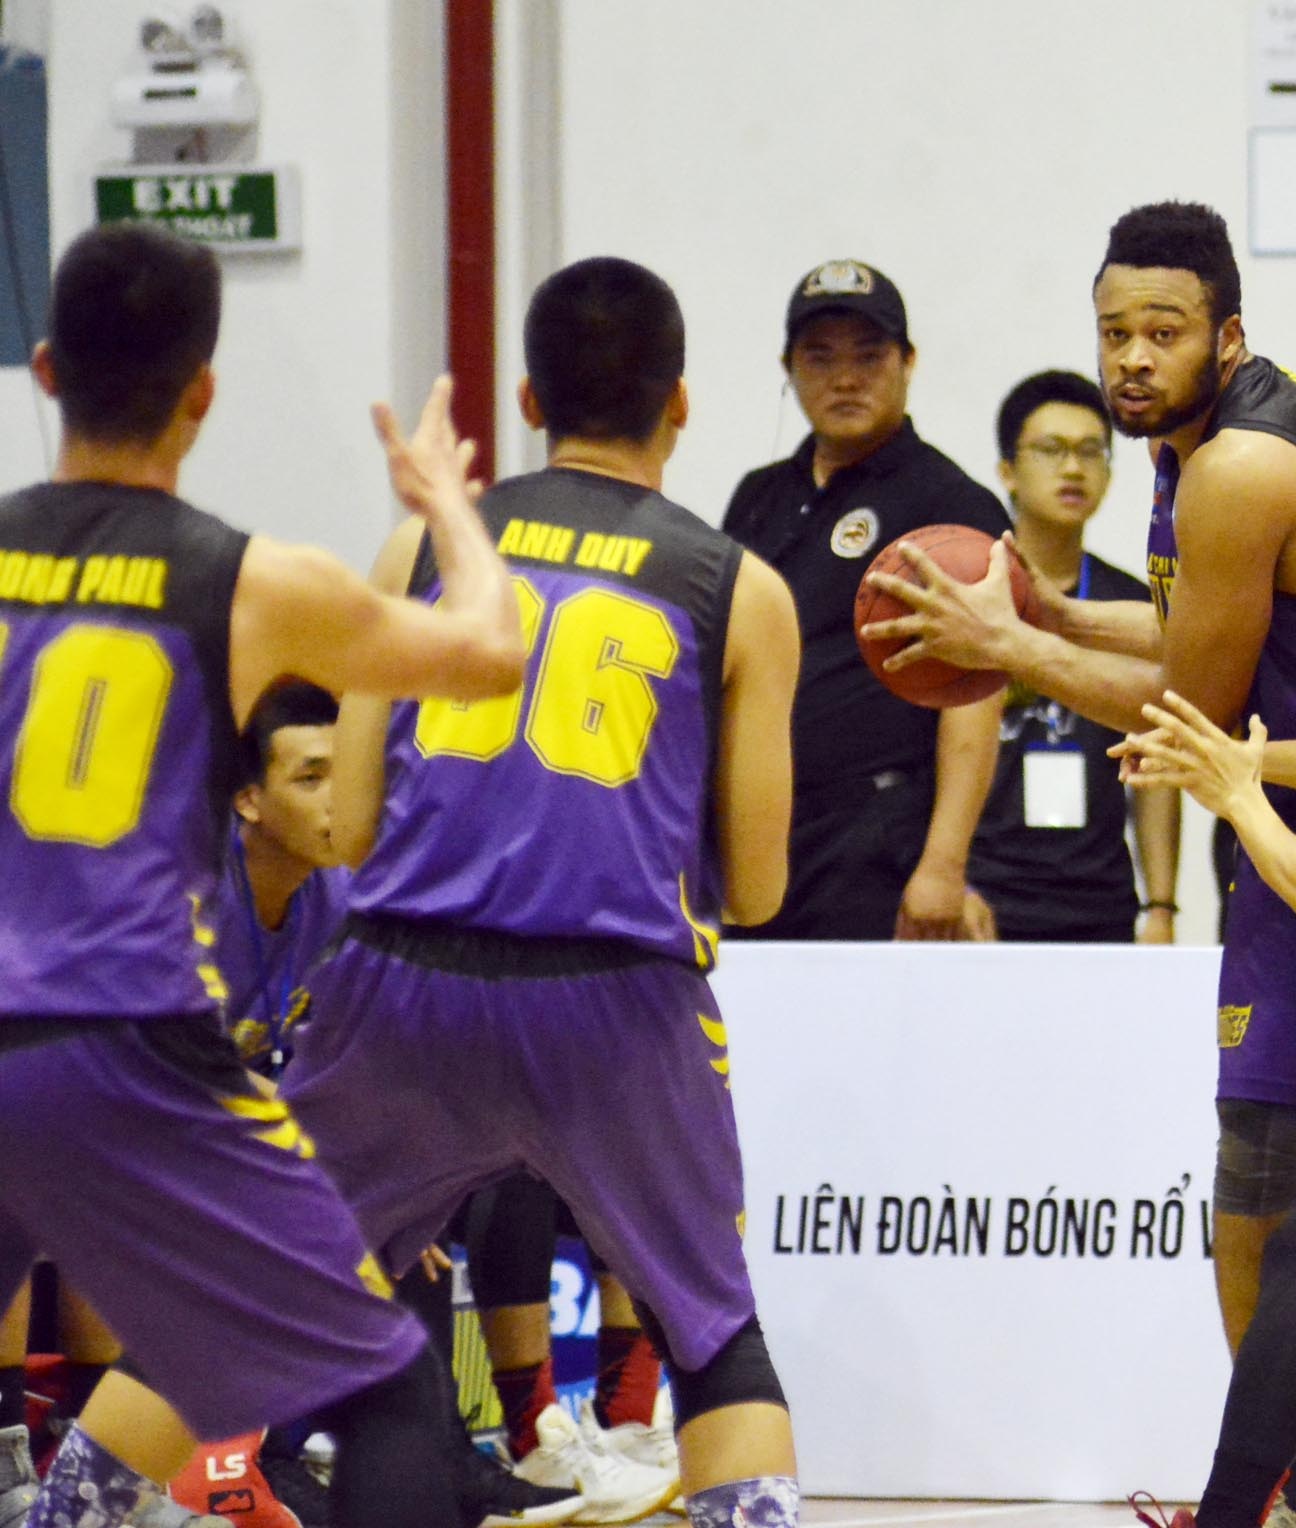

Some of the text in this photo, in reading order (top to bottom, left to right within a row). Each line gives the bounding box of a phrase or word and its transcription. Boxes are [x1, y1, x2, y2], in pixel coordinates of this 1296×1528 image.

[133, 178, 236, 212] EXIT
[497, 518, 653, 577] ANH DUY
[76, 554, 168, 610] PAUL
[773, 1183, 865, 1255] LIÊN
[876, 1184, 992, 1257] ĐOÀN
[1004, 1185, 1117, 1259] BÓNG
[1130, 1172, 1192, 1259] RỔ
[206, 1453, 247, 1482] LS
